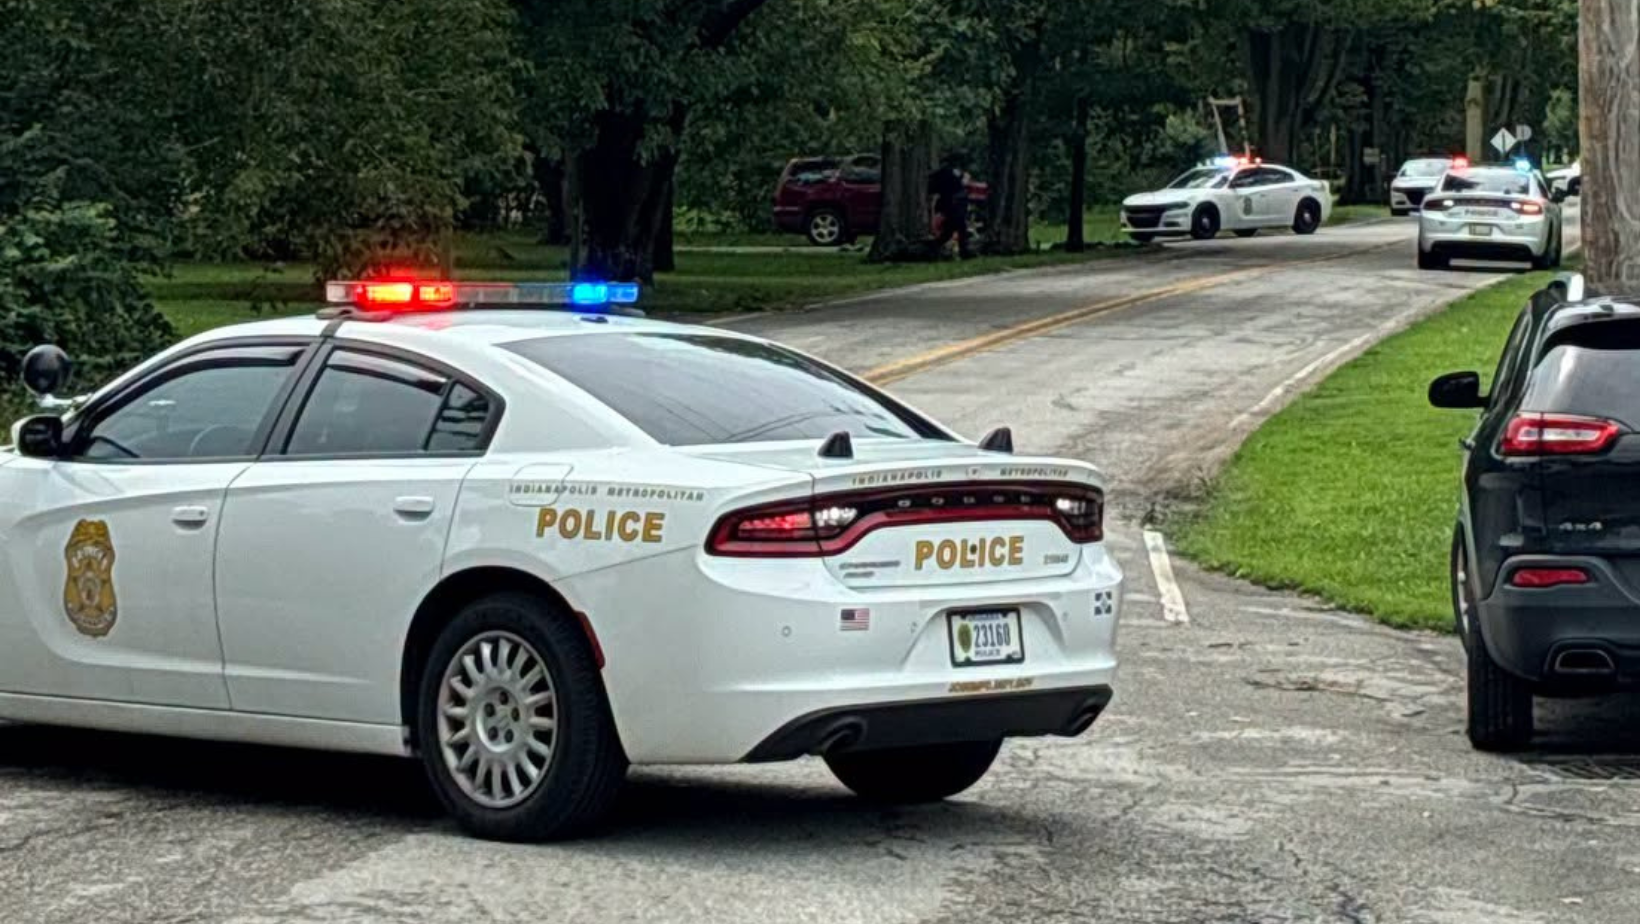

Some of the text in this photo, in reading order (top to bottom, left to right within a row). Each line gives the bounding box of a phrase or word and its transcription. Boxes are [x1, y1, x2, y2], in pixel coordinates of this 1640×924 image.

[852, 470, 942, 486] INDIANAPOLIS
[509, 484, 704, 502] INDIANAPOLIS METROPOLITAN
[536, 508, 666, 543] POLICE
[914, 535, 1025, 571] POLICE
